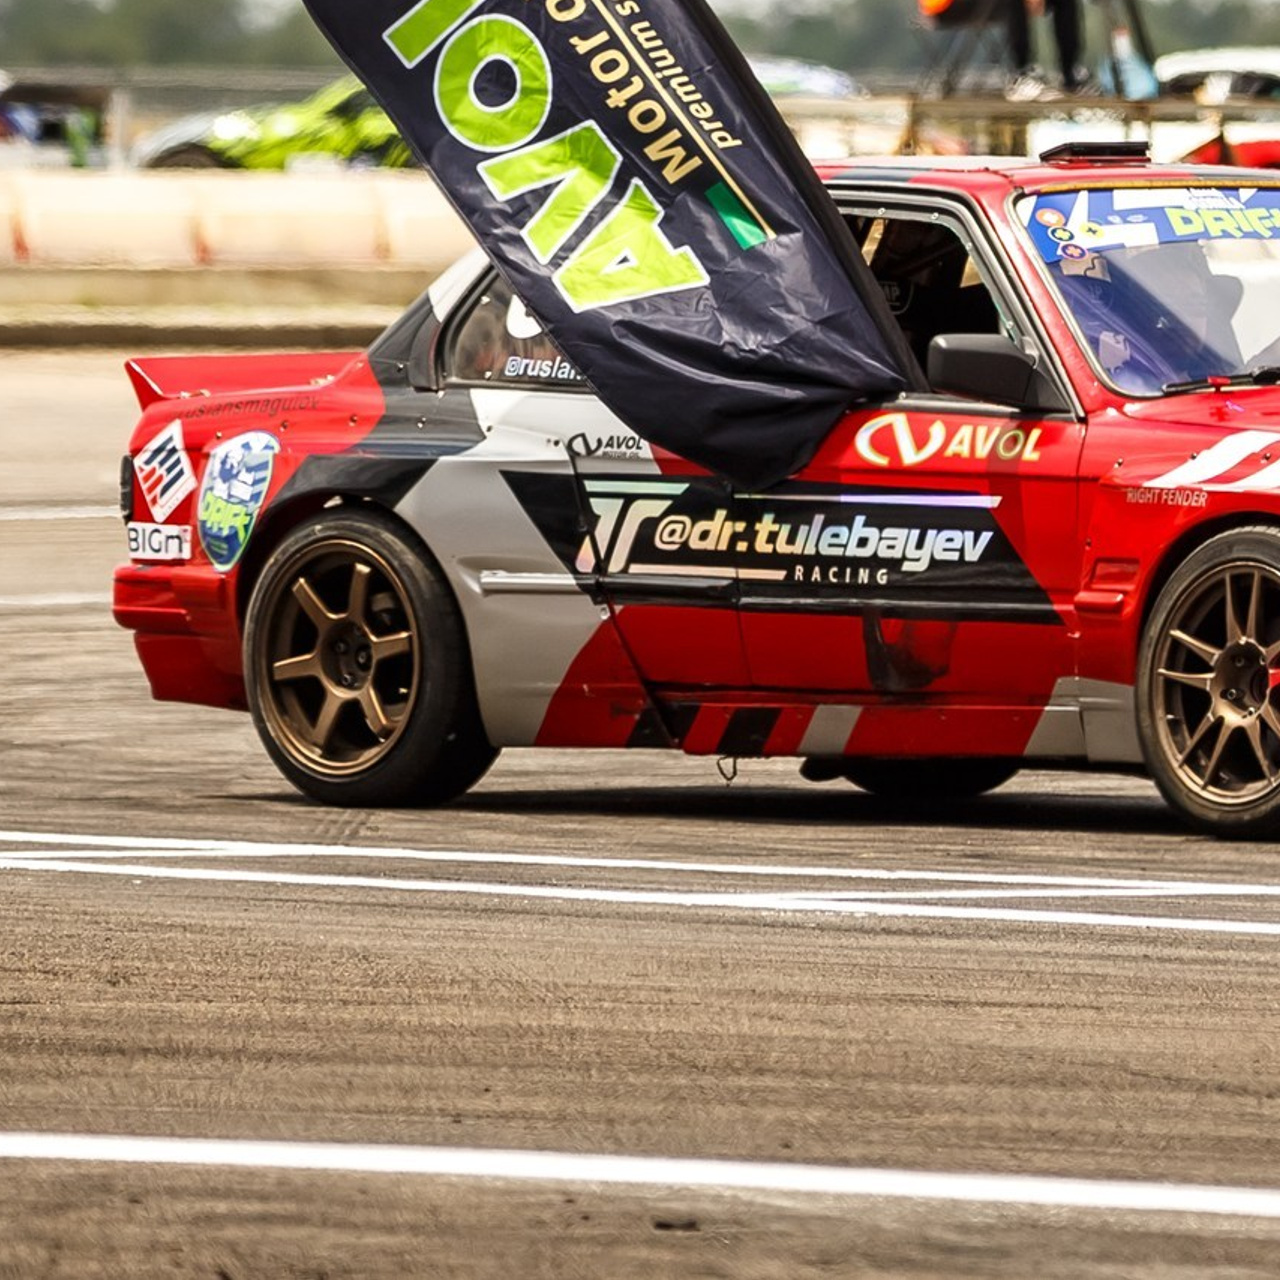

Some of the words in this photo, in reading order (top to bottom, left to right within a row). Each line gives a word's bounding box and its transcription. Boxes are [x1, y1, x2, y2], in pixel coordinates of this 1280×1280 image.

[631, 21, 742, 150] premium
[569, 30, 703, 185] Motor
[603, 435, 643, 451] AVOL
[944, 424, 1042, 461] AVOL
[1126, 487, 1160, 504] RIGHT
[1161, 489, 1208, 508] FENDER
[654, 508, 994, 572] @dr.tulebayev
[794, 565, 889, 585] RACING
